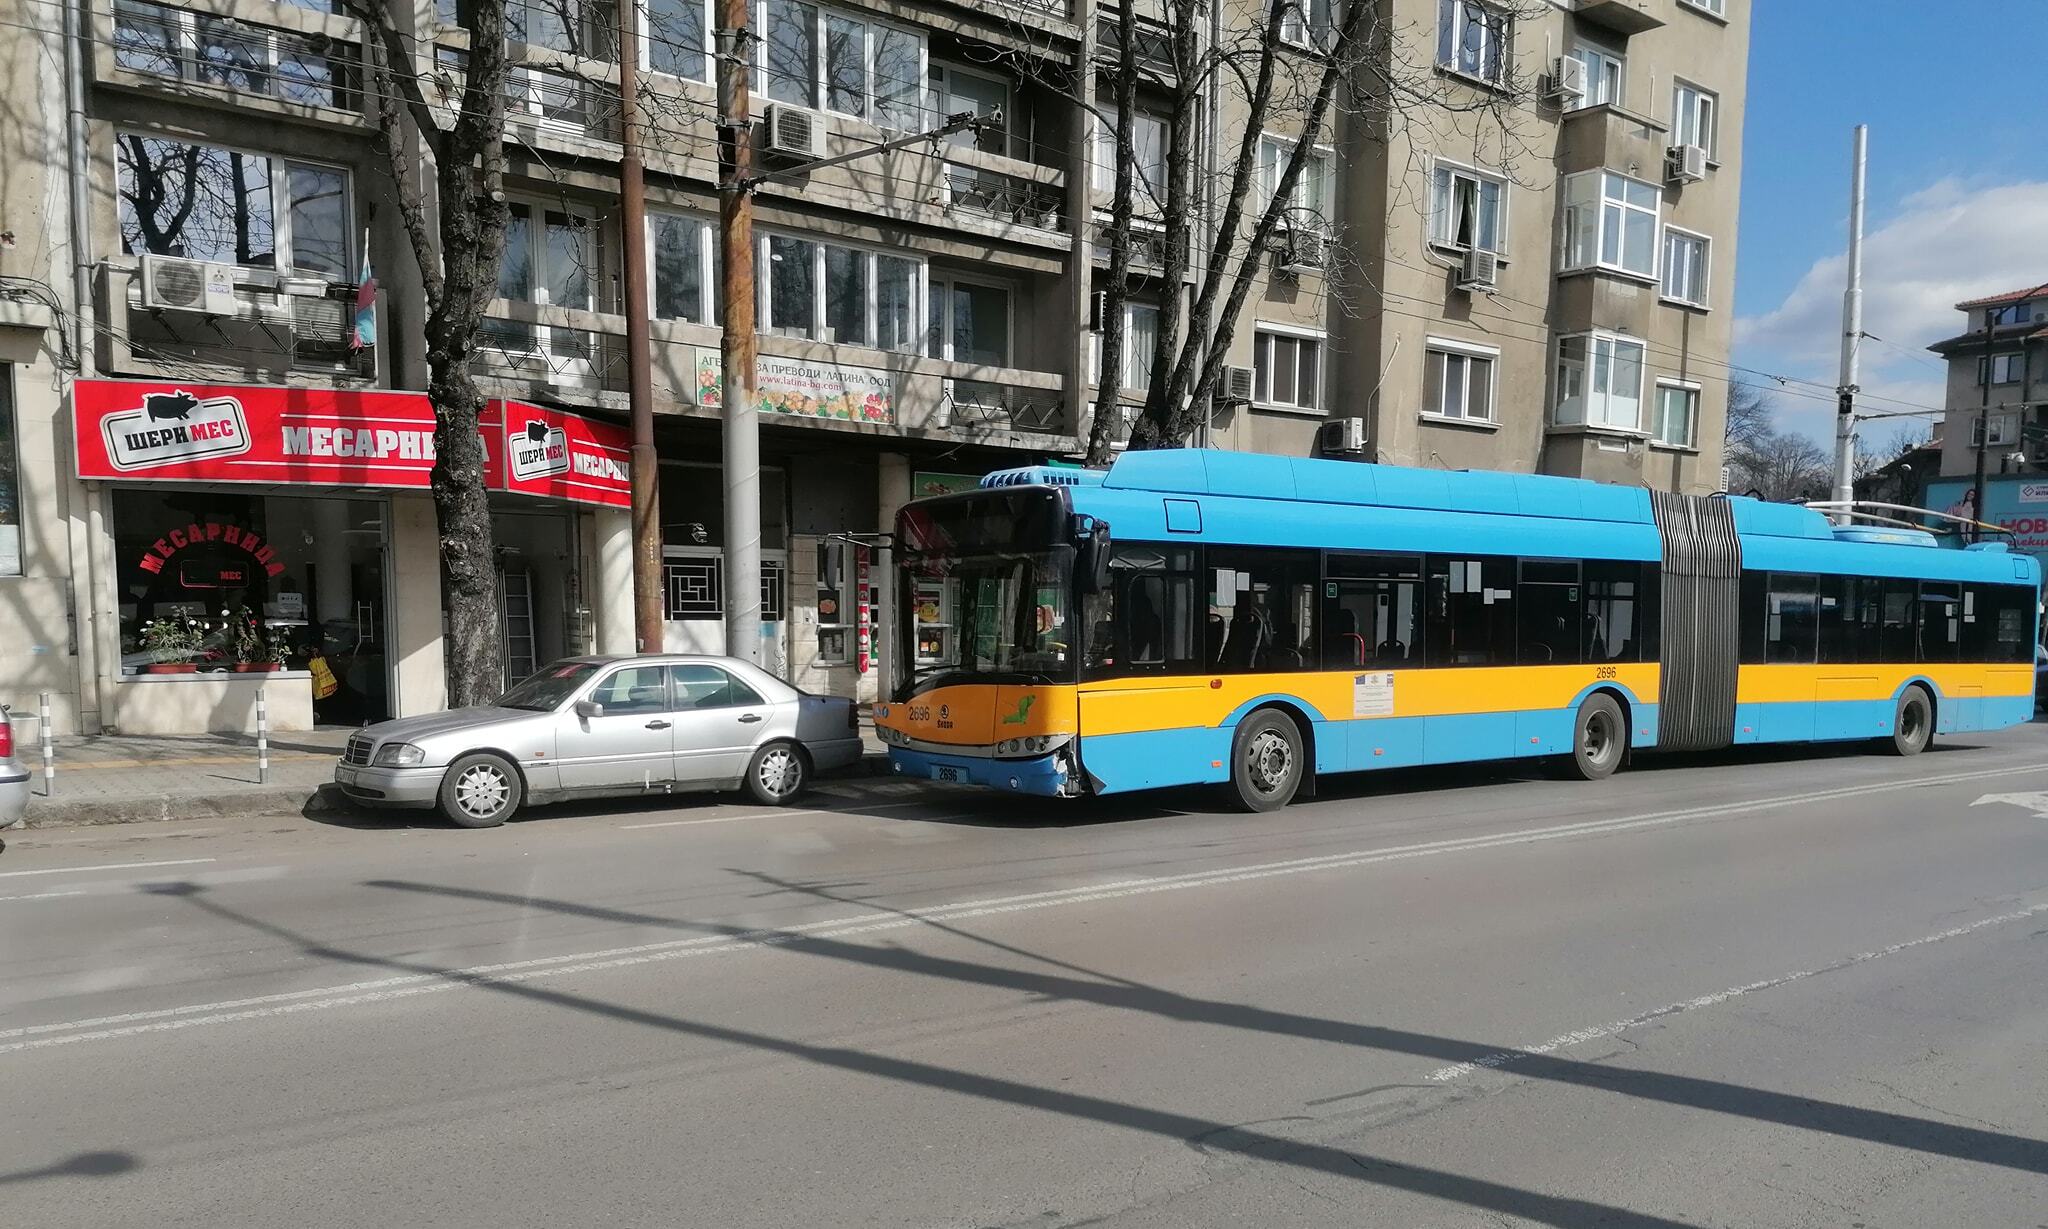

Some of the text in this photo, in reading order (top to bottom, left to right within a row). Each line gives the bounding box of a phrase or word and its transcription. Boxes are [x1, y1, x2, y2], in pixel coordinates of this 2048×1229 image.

[701, 355, 722, 366] АГЕ
[756, 362, 769, 373] ЗА
[771, 364, 821, 378] ПРЕВОДИ
[869, 376, 891, 388] ООД
[759, 376, 843, 391] www.latina-bg.com
[125, 419, 234, 451] ШЕРИ МЕС
[545, 444, 564, 461] МЕС
[139, 522, 286, 577] МЕСАРНИЦА
[220, 571, 242, 580] МЕС
[1596, 666, 1617, 679] 2696
[908, 706, 930, 721] 2696
[939, 767, 958, 782] 2696
